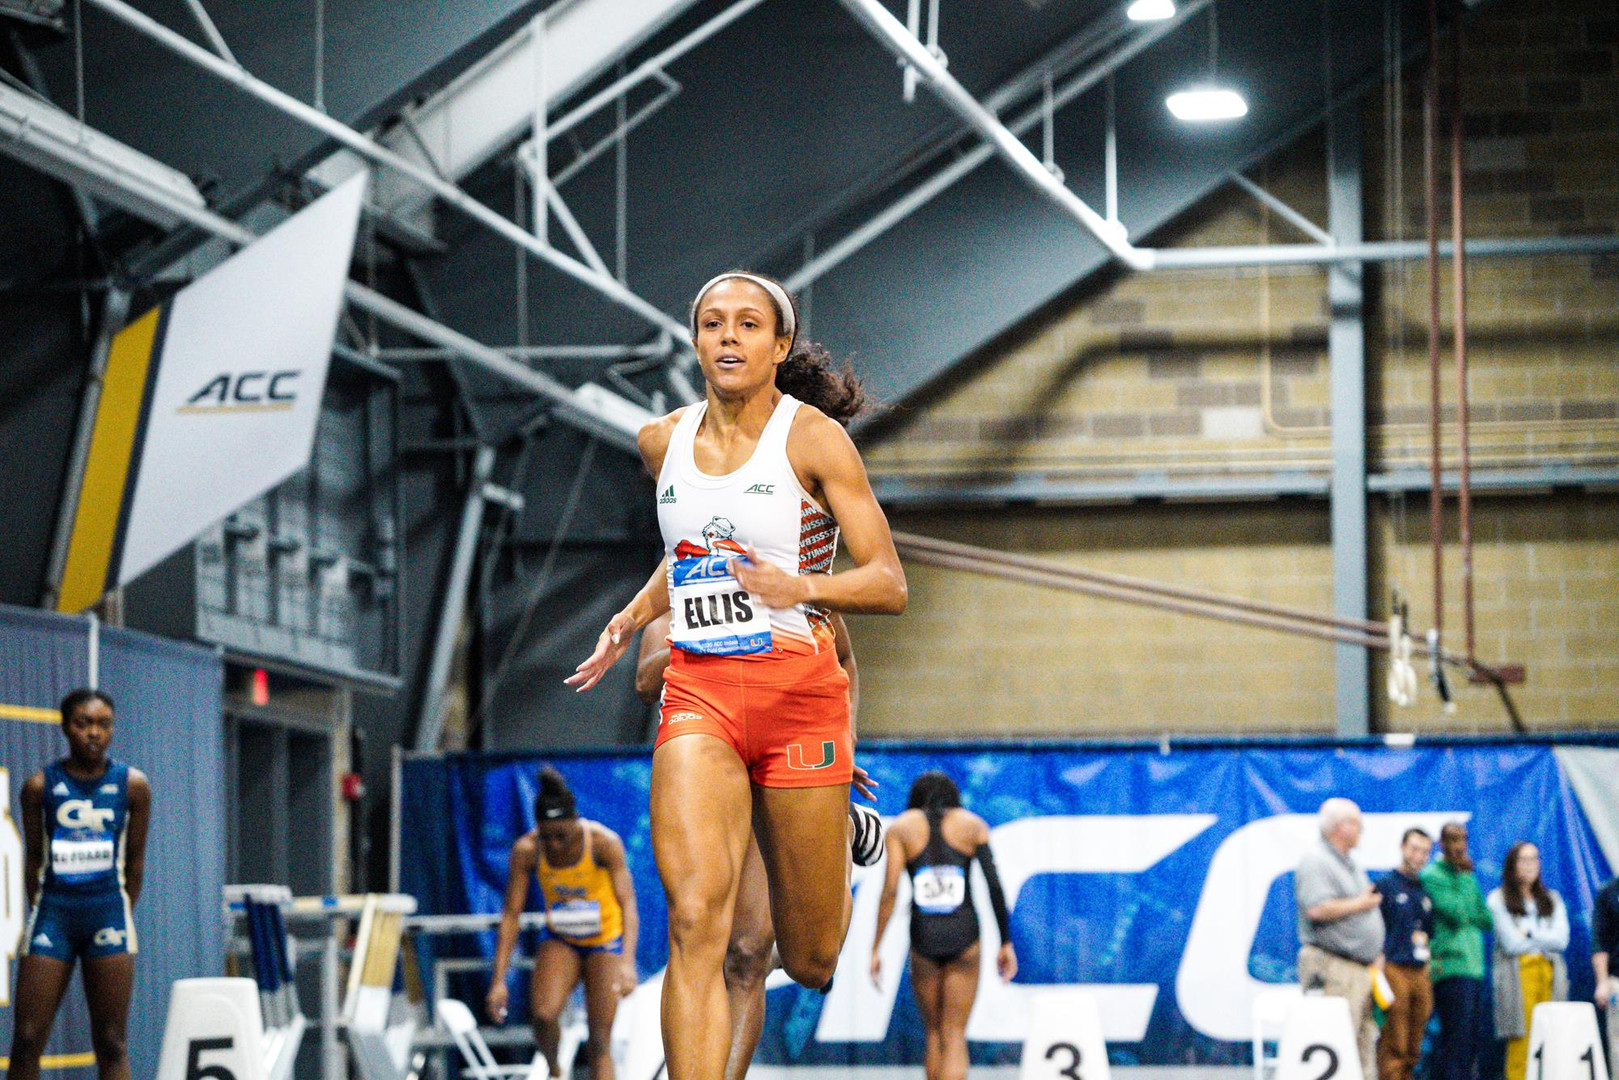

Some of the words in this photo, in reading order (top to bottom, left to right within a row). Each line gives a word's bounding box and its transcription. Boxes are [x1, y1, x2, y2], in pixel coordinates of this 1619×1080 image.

[187, 370, 301, 403] ACC
[746, 483, 775, 493] ACC
[684, 555, 748, 578] AC
[684, 590, 753, 630] ELLIS
[786, 740, 836, 771] U
[185, 1037, 239, 1080] 5
[1044, 1041, 1082, 1080] 3
[1300, 1043, 1340, 1080] 2
[1580, 1045, 1596, 1080] 1
